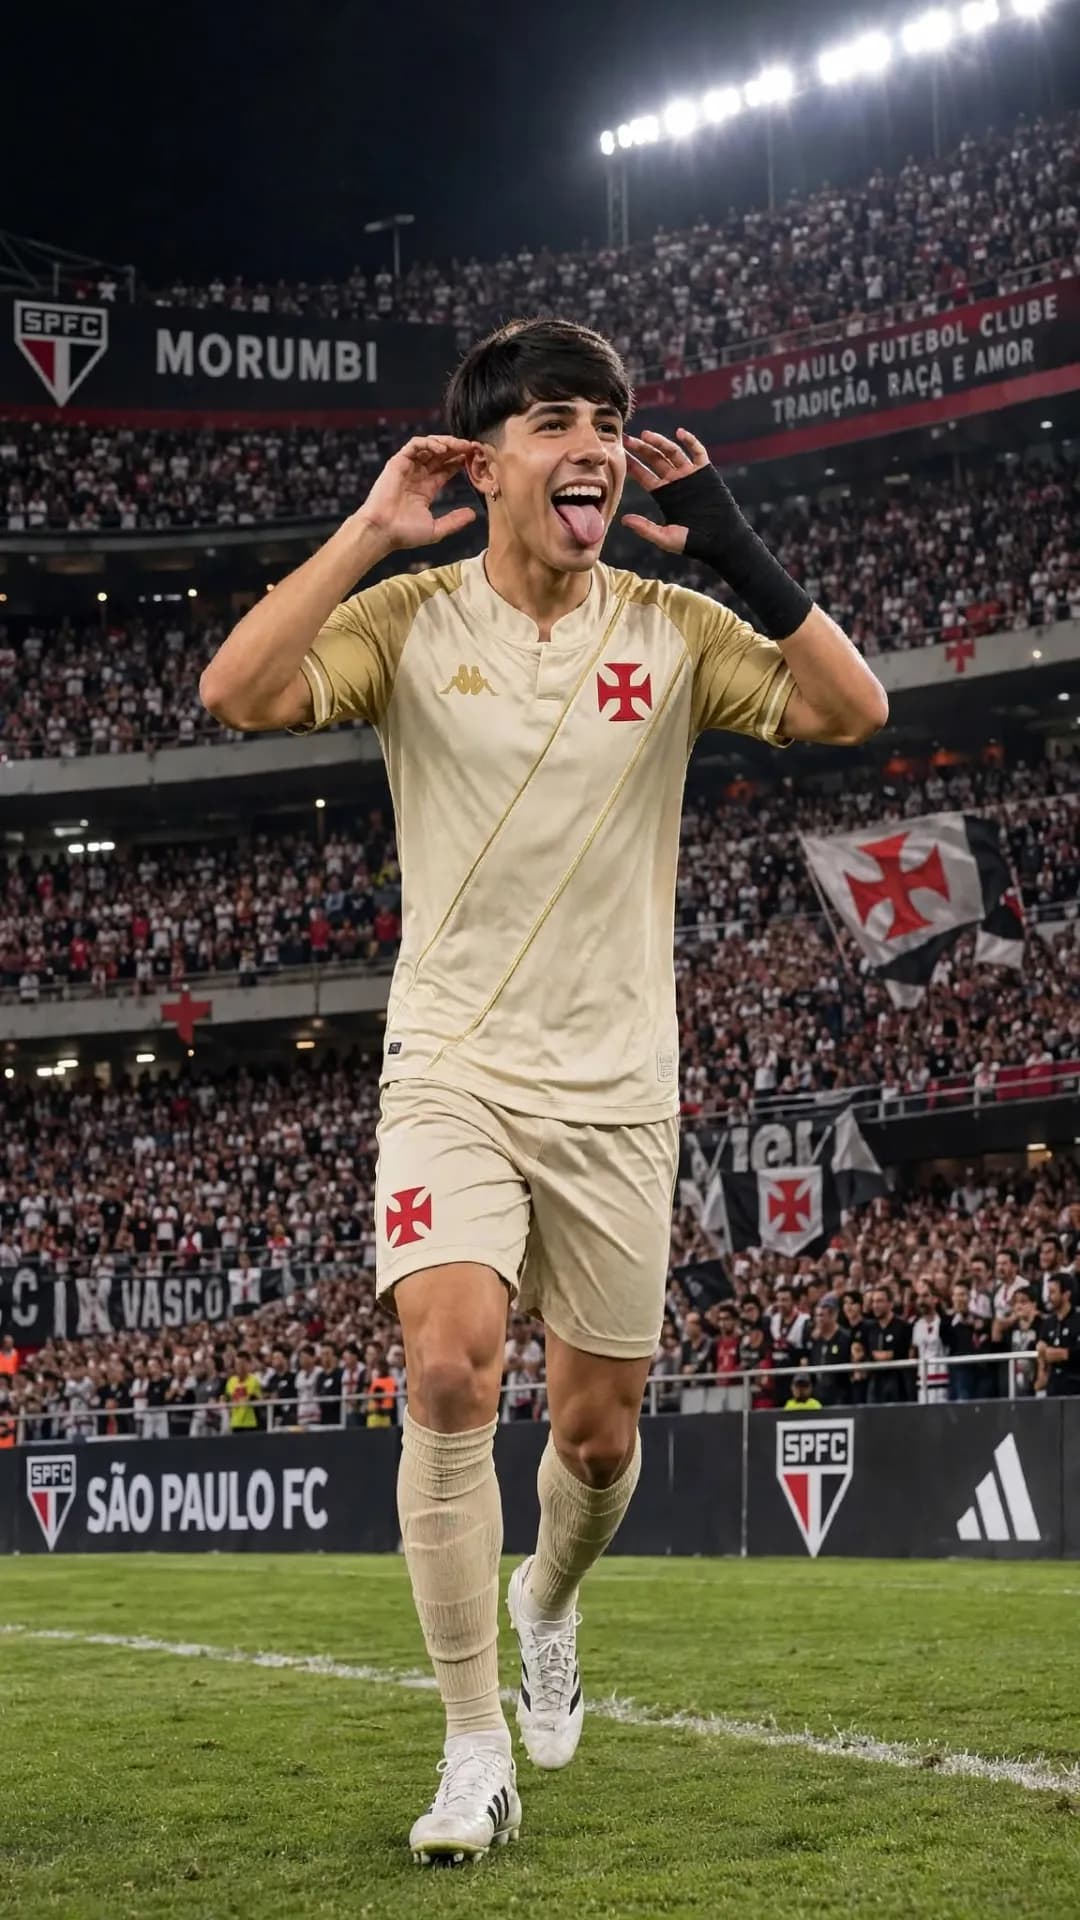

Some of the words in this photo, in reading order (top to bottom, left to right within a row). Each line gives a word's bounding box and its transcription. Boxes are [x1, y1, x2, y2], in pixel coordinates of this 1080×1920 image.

[24, 311, 99, 336] SPFC
[156, 328, 377, 383] MORUMBI
[731, 365, 774, 400] SÃO
[784, 348, 856, 388] PAULO
[868, 320, 968, 369] FUTEBOL
[980, 294, 1058, 338] CLUBE
[953, 357, 965, 381] E
[975, 338, 1034, 377] AMOR
[121, 1278, 223, 1328] VASCO
[784, 1433, 847, 1462] SPFC
[32, 1463, 73, 1485] SPFC
[87, 1462, 154, 1533] SÃO
[161, 1468, 275, 1531] PAULO
[283, 1467, 328, 1530] FC
